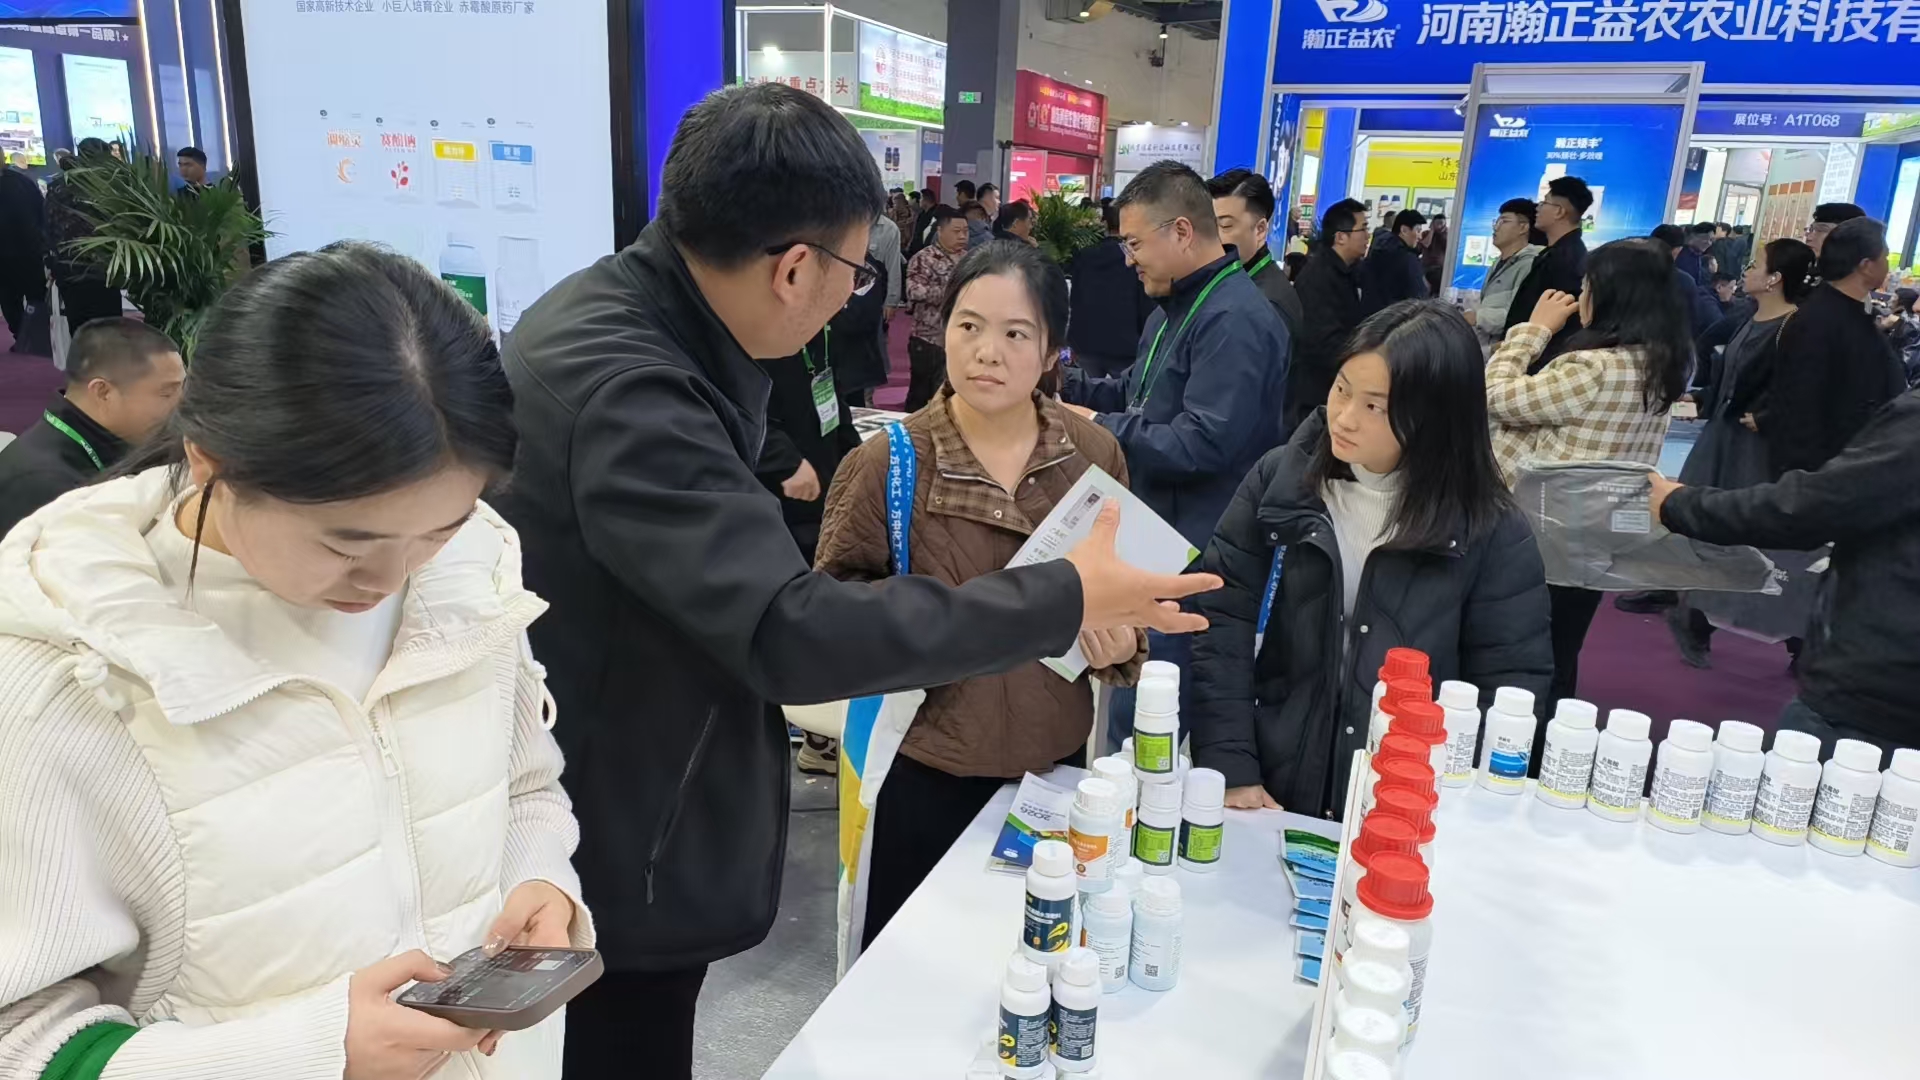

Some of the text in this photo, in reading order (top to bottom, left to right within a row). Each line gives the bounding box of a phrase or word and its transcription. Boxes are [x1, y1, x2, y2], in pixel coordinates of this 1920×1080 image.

[296, 0, 535, 14] 国家高新技术企业 小巨人培育企业 赤霉酸原药厂家
[1416, 0, 1920, 45] 河南瀚正益农农业科技有
[1302, 27, 1397, 50] 瀚正益农
[1020, 806, 1052, 821] 2026
